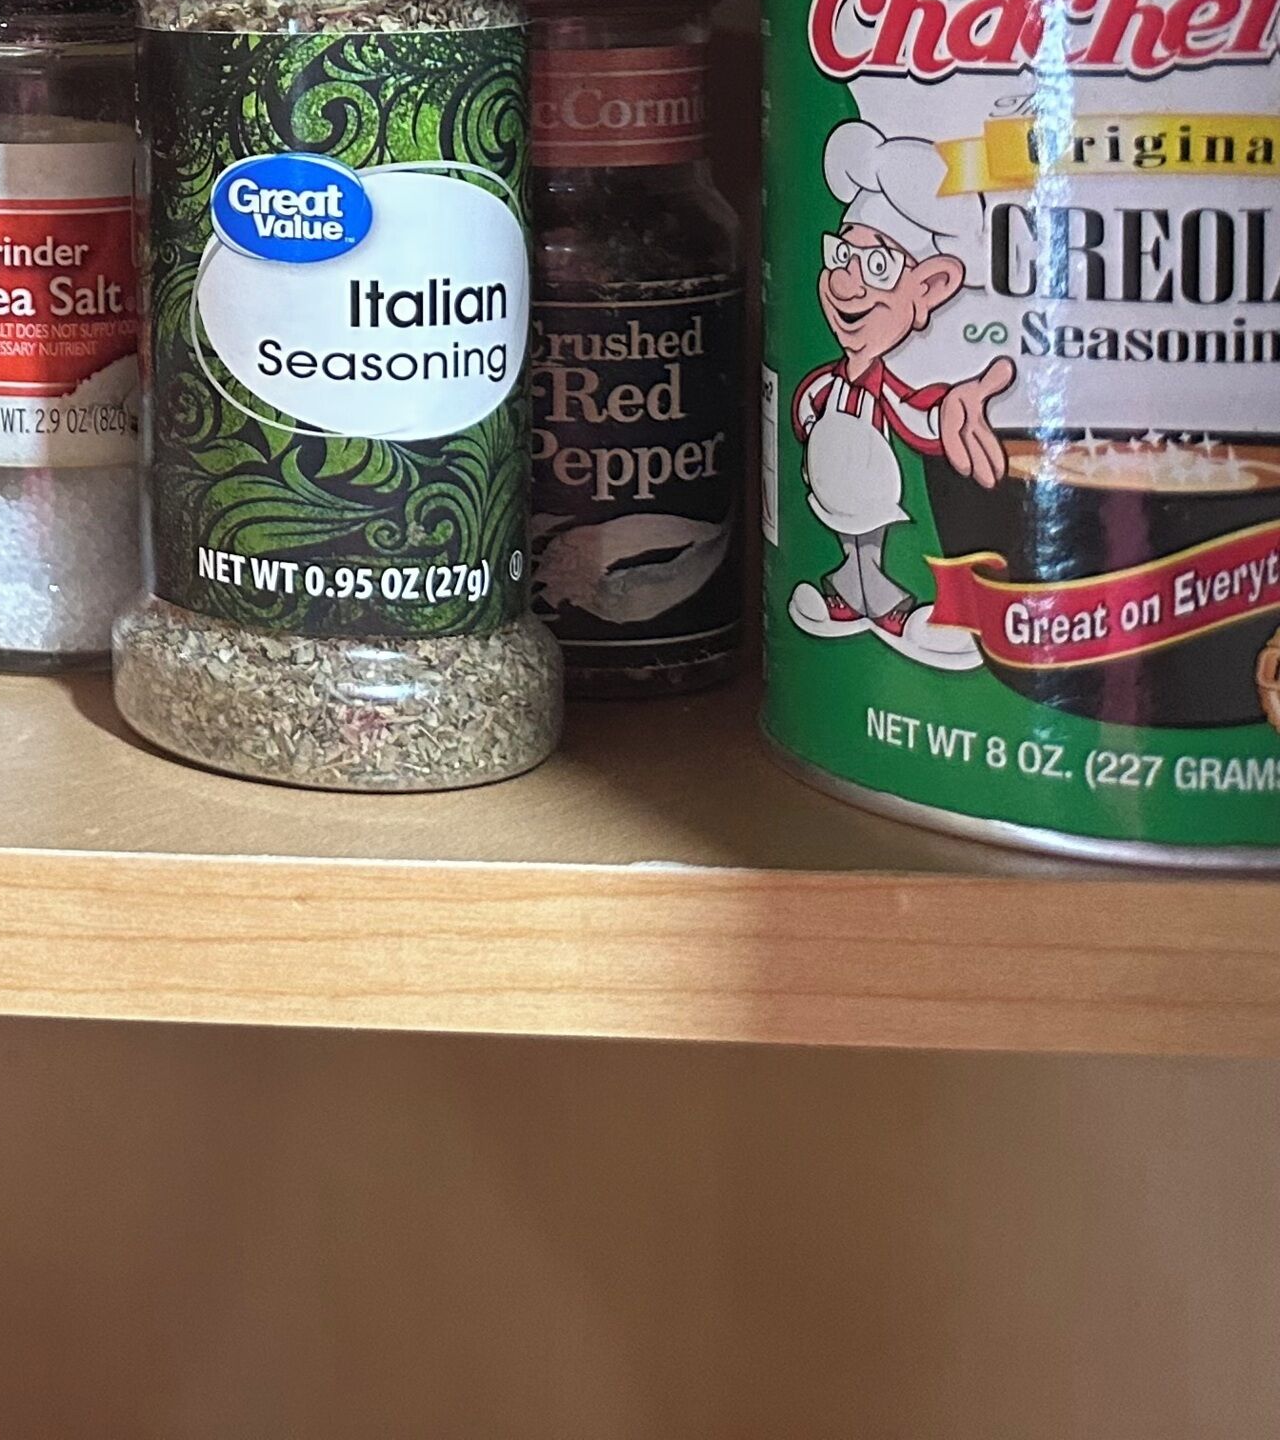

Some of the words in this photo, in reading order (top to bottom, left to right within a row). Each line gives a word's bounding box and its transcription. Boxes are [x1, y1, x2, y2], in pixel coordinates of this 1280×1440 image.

[227, 177, 343, 218] Great
[252, 214, 343, 242] Value
[50, 276, 123, 315] Salt
[349, 278, 507, 328] Italian
[16, 323, 49, 339] DOES
[51, 324, 78, 339] NOT
[80, 322, 114, 339] SUPPLY
[39, 342, 97, 357] NUTRIENT
[532, 316, 704, 362] rushed
[257, 337, 508, 383] Seasoning
[536, 363, 687, 424] Red
[0, 407, 30, 433] WT.
[35, 408, 60, 434] 2.9
[67, 408, 88, 433] OZ
[198, 547, 246, 585] NET
[251, 557, 298, 593] WT
[304, 566, 373, 599] 0.95
[381, 566, 420, 599] OZ
[425, 560, 489, 603] (27g)
[1005, 601, 1107, 646] Great
[1120, 593, 1161, 631] on
[867, 708, 921, 750] NET
[926, 722, 976, 761] WT
[986, 737, 1007, 767] 8
[1021, 742, 1072, 780] OZ.
[1086, 749, 1162, 788] (227
